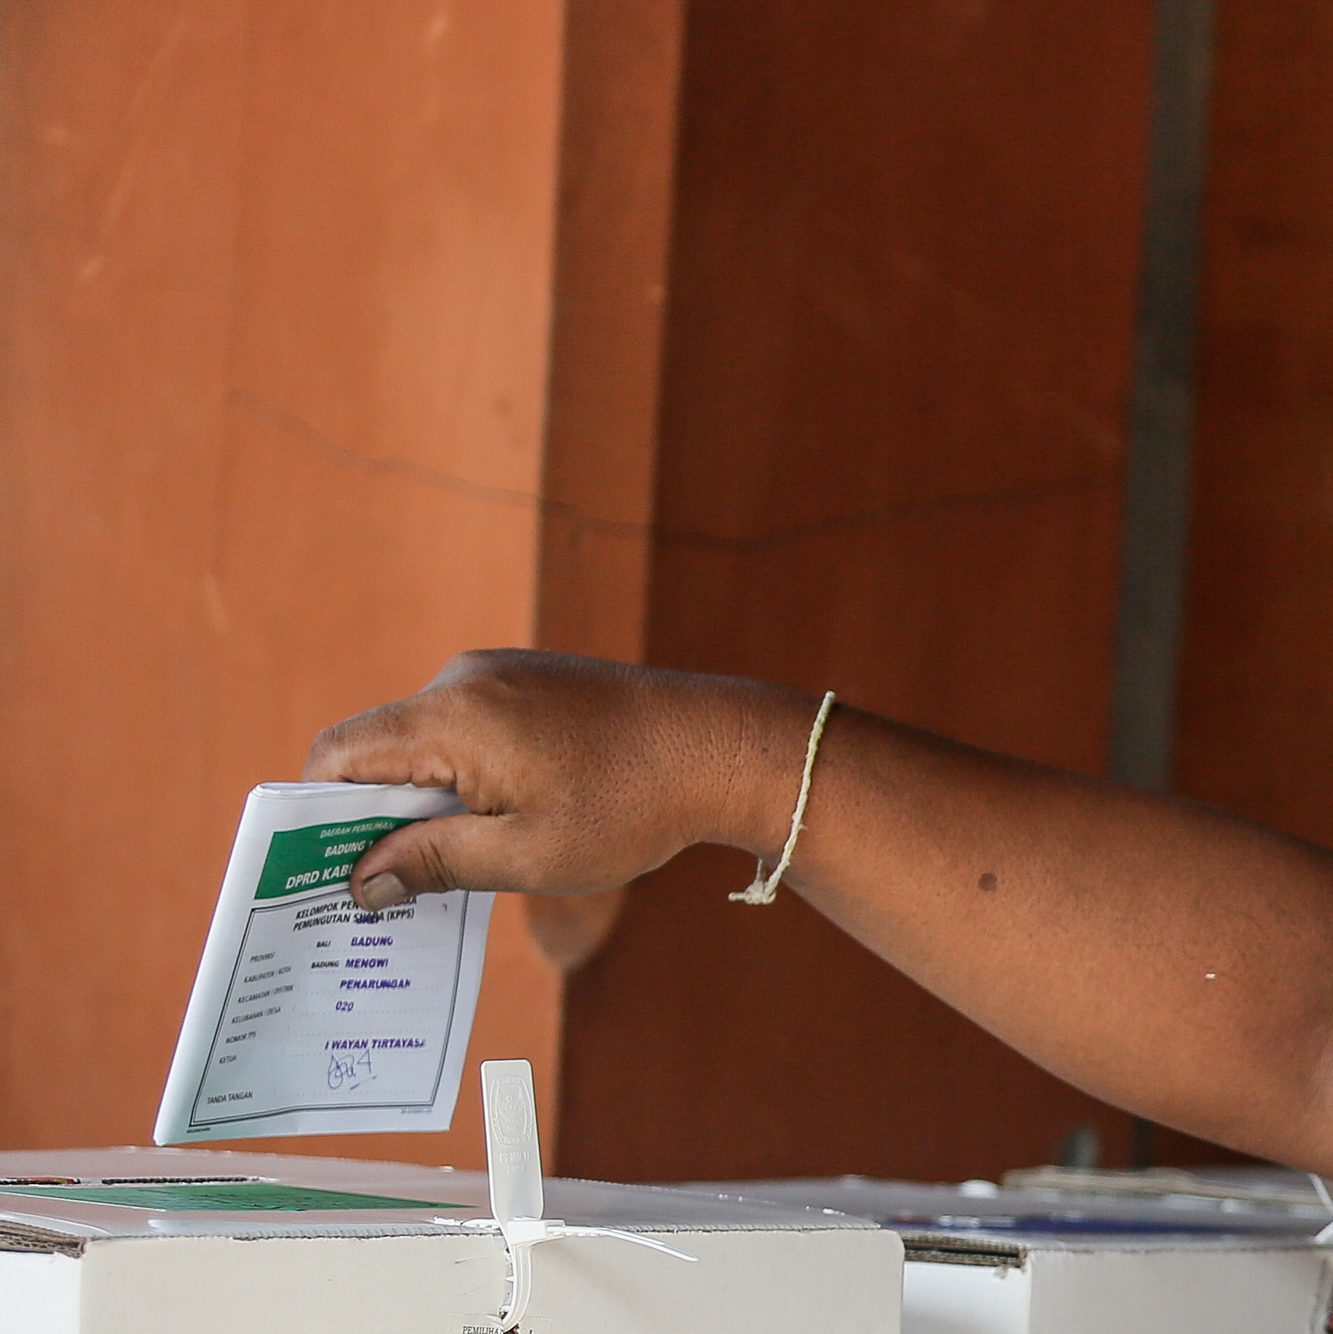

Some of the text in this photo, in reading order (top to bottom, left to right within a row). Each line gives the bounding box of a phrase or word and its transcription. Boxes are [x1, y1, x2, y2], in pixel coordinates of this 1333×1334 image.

[325, 840, 366, 857] BADUNG
[285, 870, 319, 889] DPRD
[295, 901, 339, 919] KELOMPOK
[293, 914, 350, 931] PEMUNGUTAN
[387, 908, 415, 921] (KPPS)
[351, 936, 394, 947] BADUNG
[340, 979, 411, 989] PENARUNGAN
[335, 1001, 354, 1012] 020
[331, 1039, 369, 1050] WAYAN
